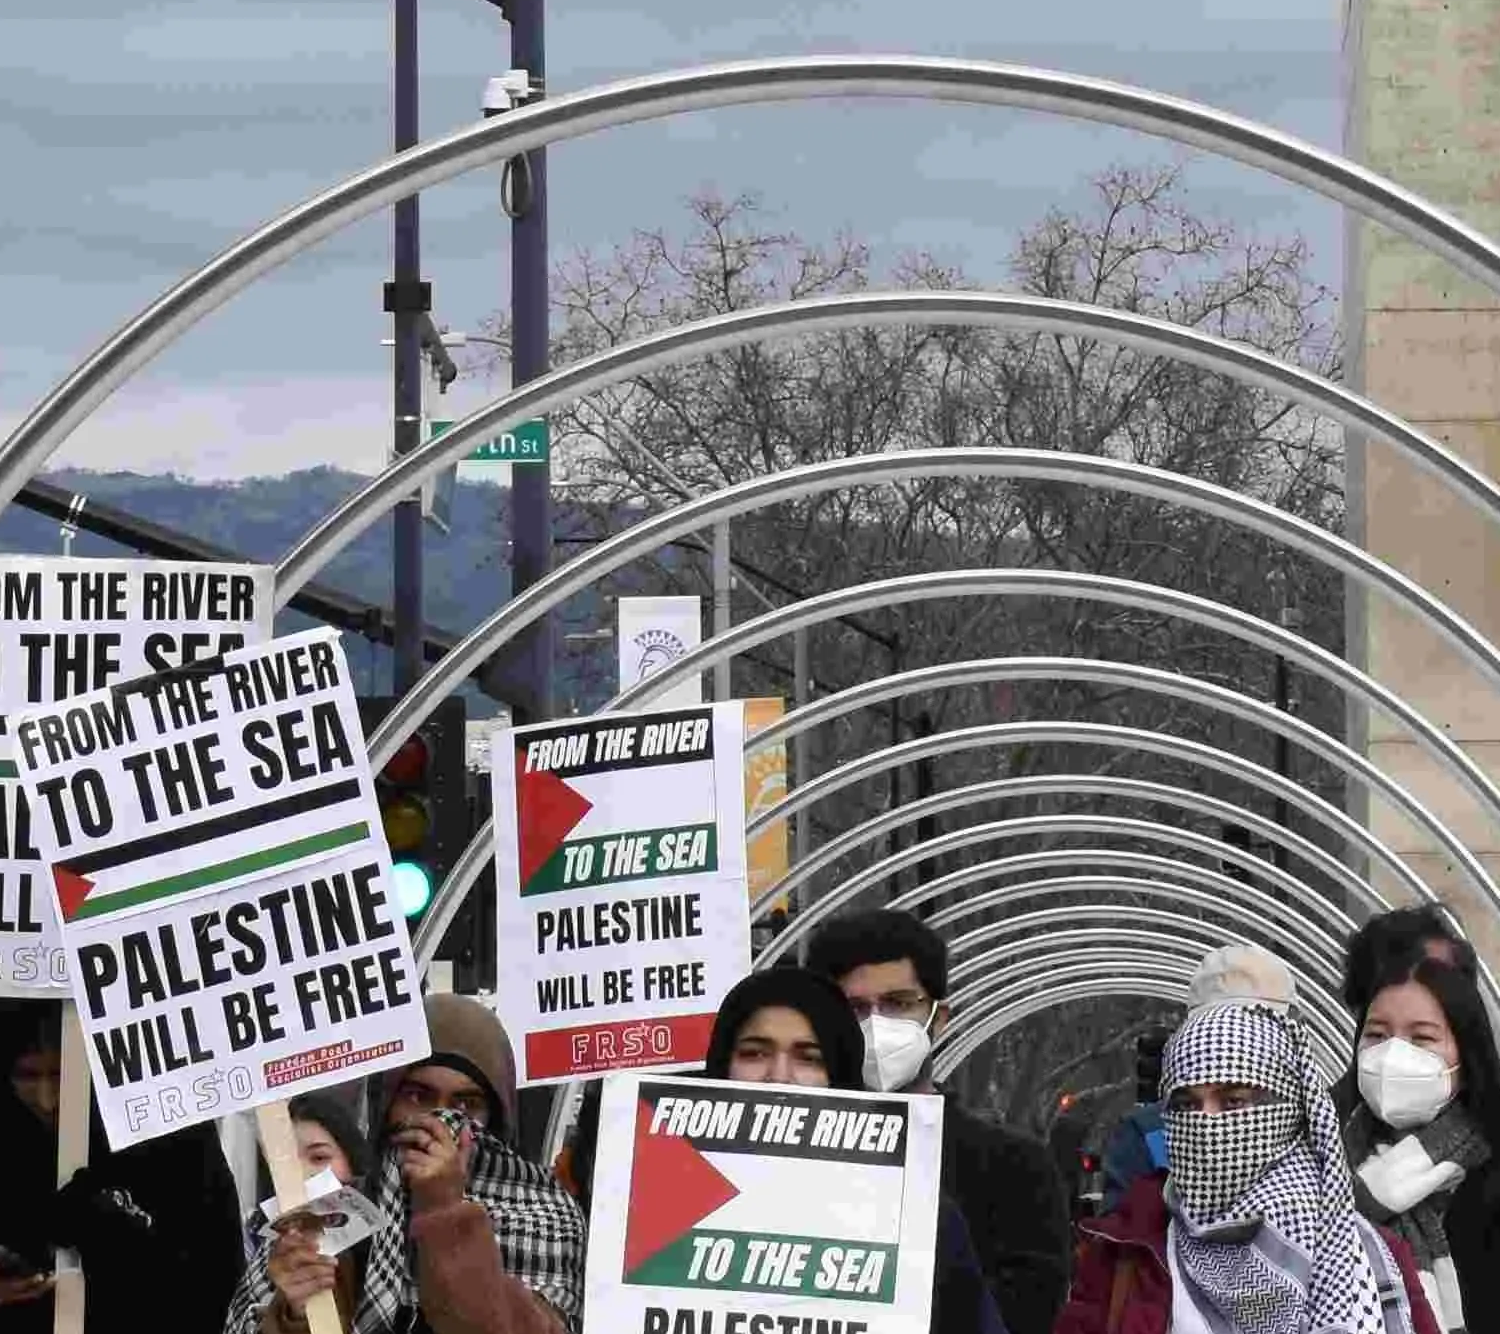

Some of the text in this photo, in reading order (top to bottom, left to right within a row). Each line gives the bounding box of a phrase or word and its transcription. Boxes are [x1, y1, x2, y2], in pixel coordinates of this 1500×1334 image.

[57, 571, 128, 621] THE
[143, 572, 255, 622] RIVER
[19, 632, 121, 704] THE
[17, 640, 341, 771] FROM THE RIVER
[37, 767, 114, 849] TO
[124, 732, 235, 824] THE
[241, 700, 355, 791] SEA
[524, 717, 710, 774] FROM THE RIVER
[562, 829, 709, 885] TO THE SEA
[77, 862, 396, 1021] PALESTINE
[536, 892, 703, 955] PALESTINE
[92, 947, 412, 1090] WILL BE FREE
[536, 961, 707, 1015] WILL BE FREE
[649, 1096, 904, 1154] FROM THE RIVER
[687, 1236, 888, 1295] TO THE SEA
